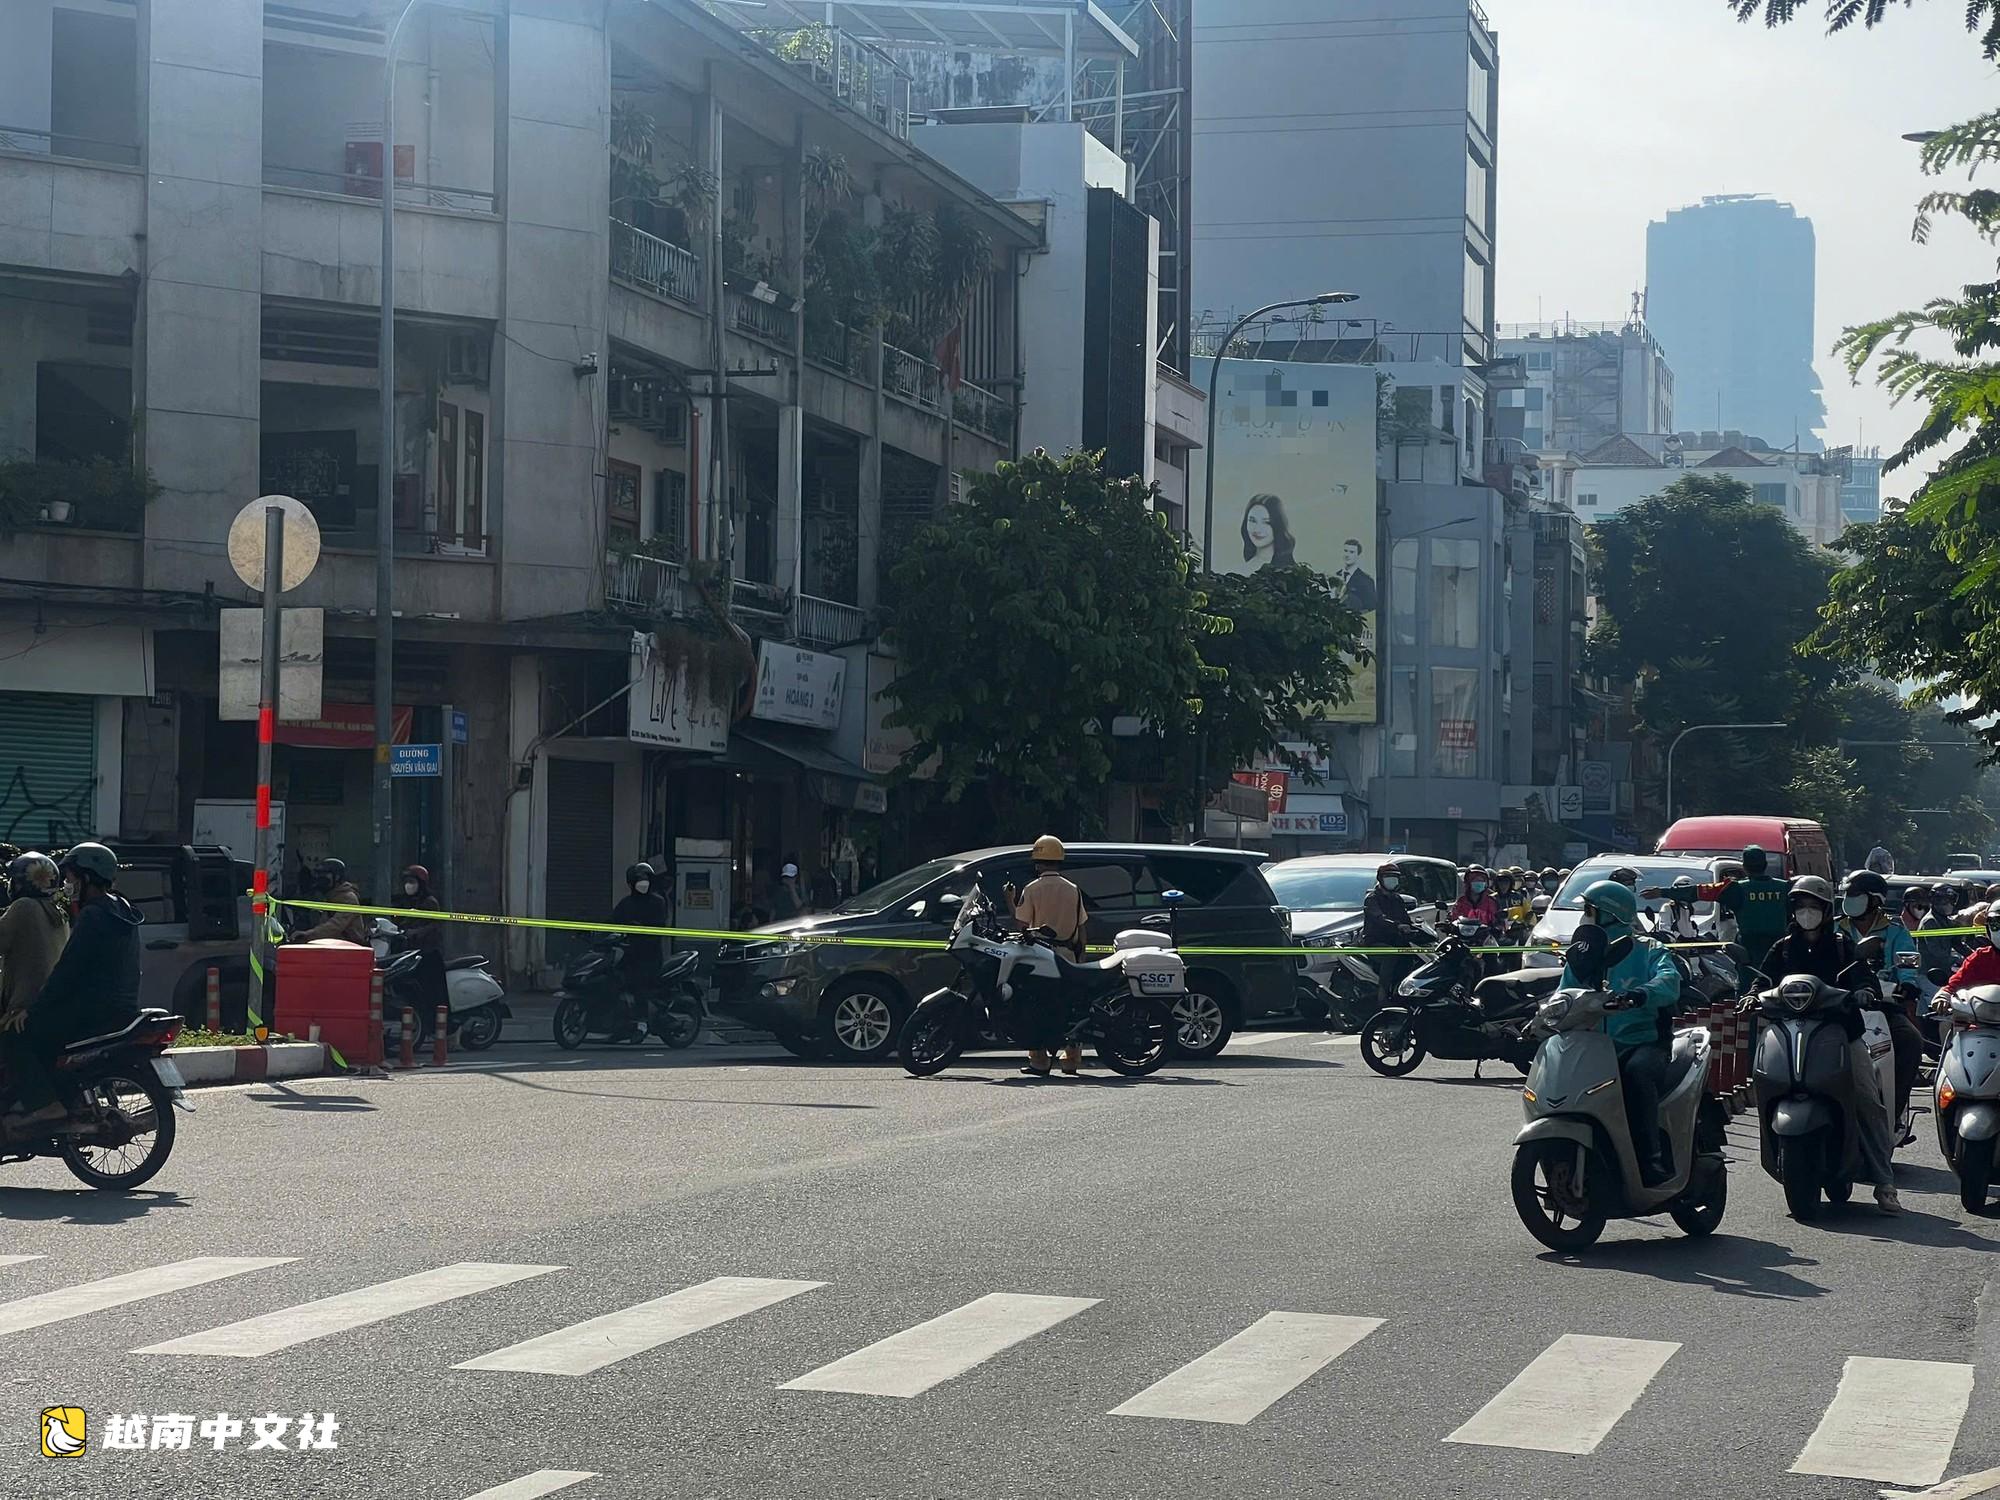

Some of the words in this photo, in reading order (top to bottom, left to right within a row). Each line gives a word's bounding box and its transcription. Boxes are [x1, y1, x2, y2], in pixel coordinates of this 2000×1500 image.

[399, 747, 429, 758] ĐƯỜNG
[414, 760, 426, 772] VĂN
[1322, 815, 1345, 825] 102
